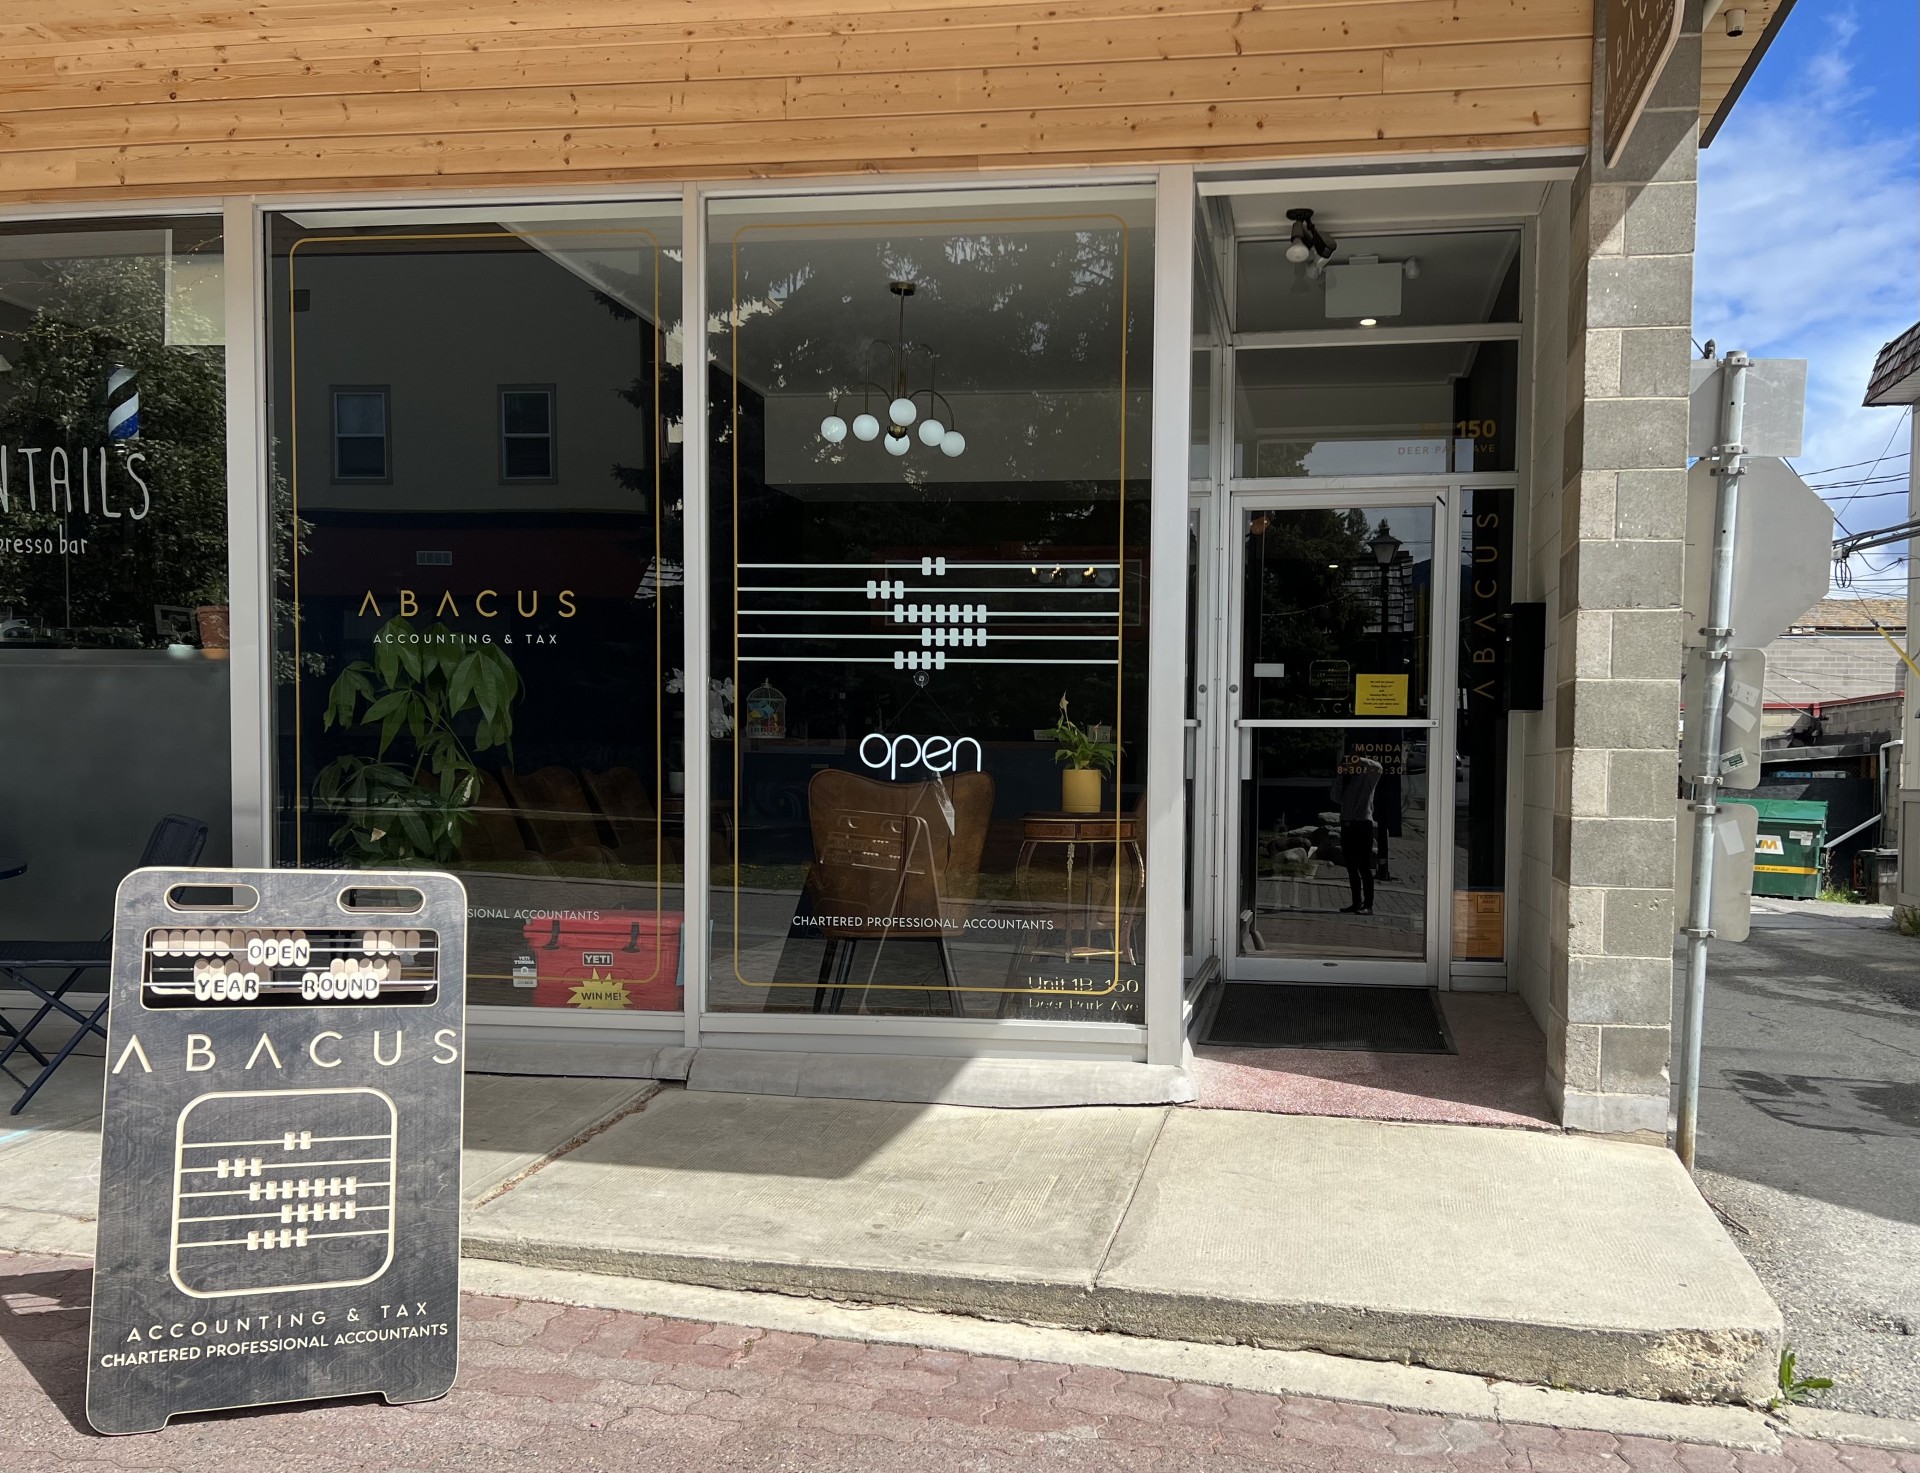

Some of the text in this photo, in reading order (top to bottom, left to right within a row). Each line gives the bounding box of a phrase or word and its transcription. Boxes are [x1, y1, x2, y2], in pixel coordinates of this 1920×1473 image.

[1456, 419, 1497, 438] 150
[1398, 446, 1429, 456] DEER
[1474, 444, 1496, 453] AVE
[59, 523, 88, 555] bar
[358, 589, 577, 618] ABACUS
[1473, 513, 1499, 700] ABACUS
[373, 634, 558, 644] ACCOUNTING & TAX
[1355, 743, 1408, 752] MONDAY
[859, 732, 982, 781] open
[1344, 755, 1360, 764] TO
[514, 909, 600, 921] ACCOUNTANTS
[792, 915, 1054, 930] CHARTERED PROFESSIONAL ACCOUNTANTS
[250, 945, 308, 960] OPEN
[585, 955, 611, 964] YETI
[198, 977, 378, 994] YEAR ROUND
[1028, 976, 1065, 991] Unit
[581, 992, 622, 1001] WIN ME!
[111, 1029, 458, 1074] ABACUS
[126, 1302, 428, 1343] ACCOUNTING & TAX
[100, 1323, 449, 1368] CHARTERED PROFESSIONAL ACCOUNTANTS
